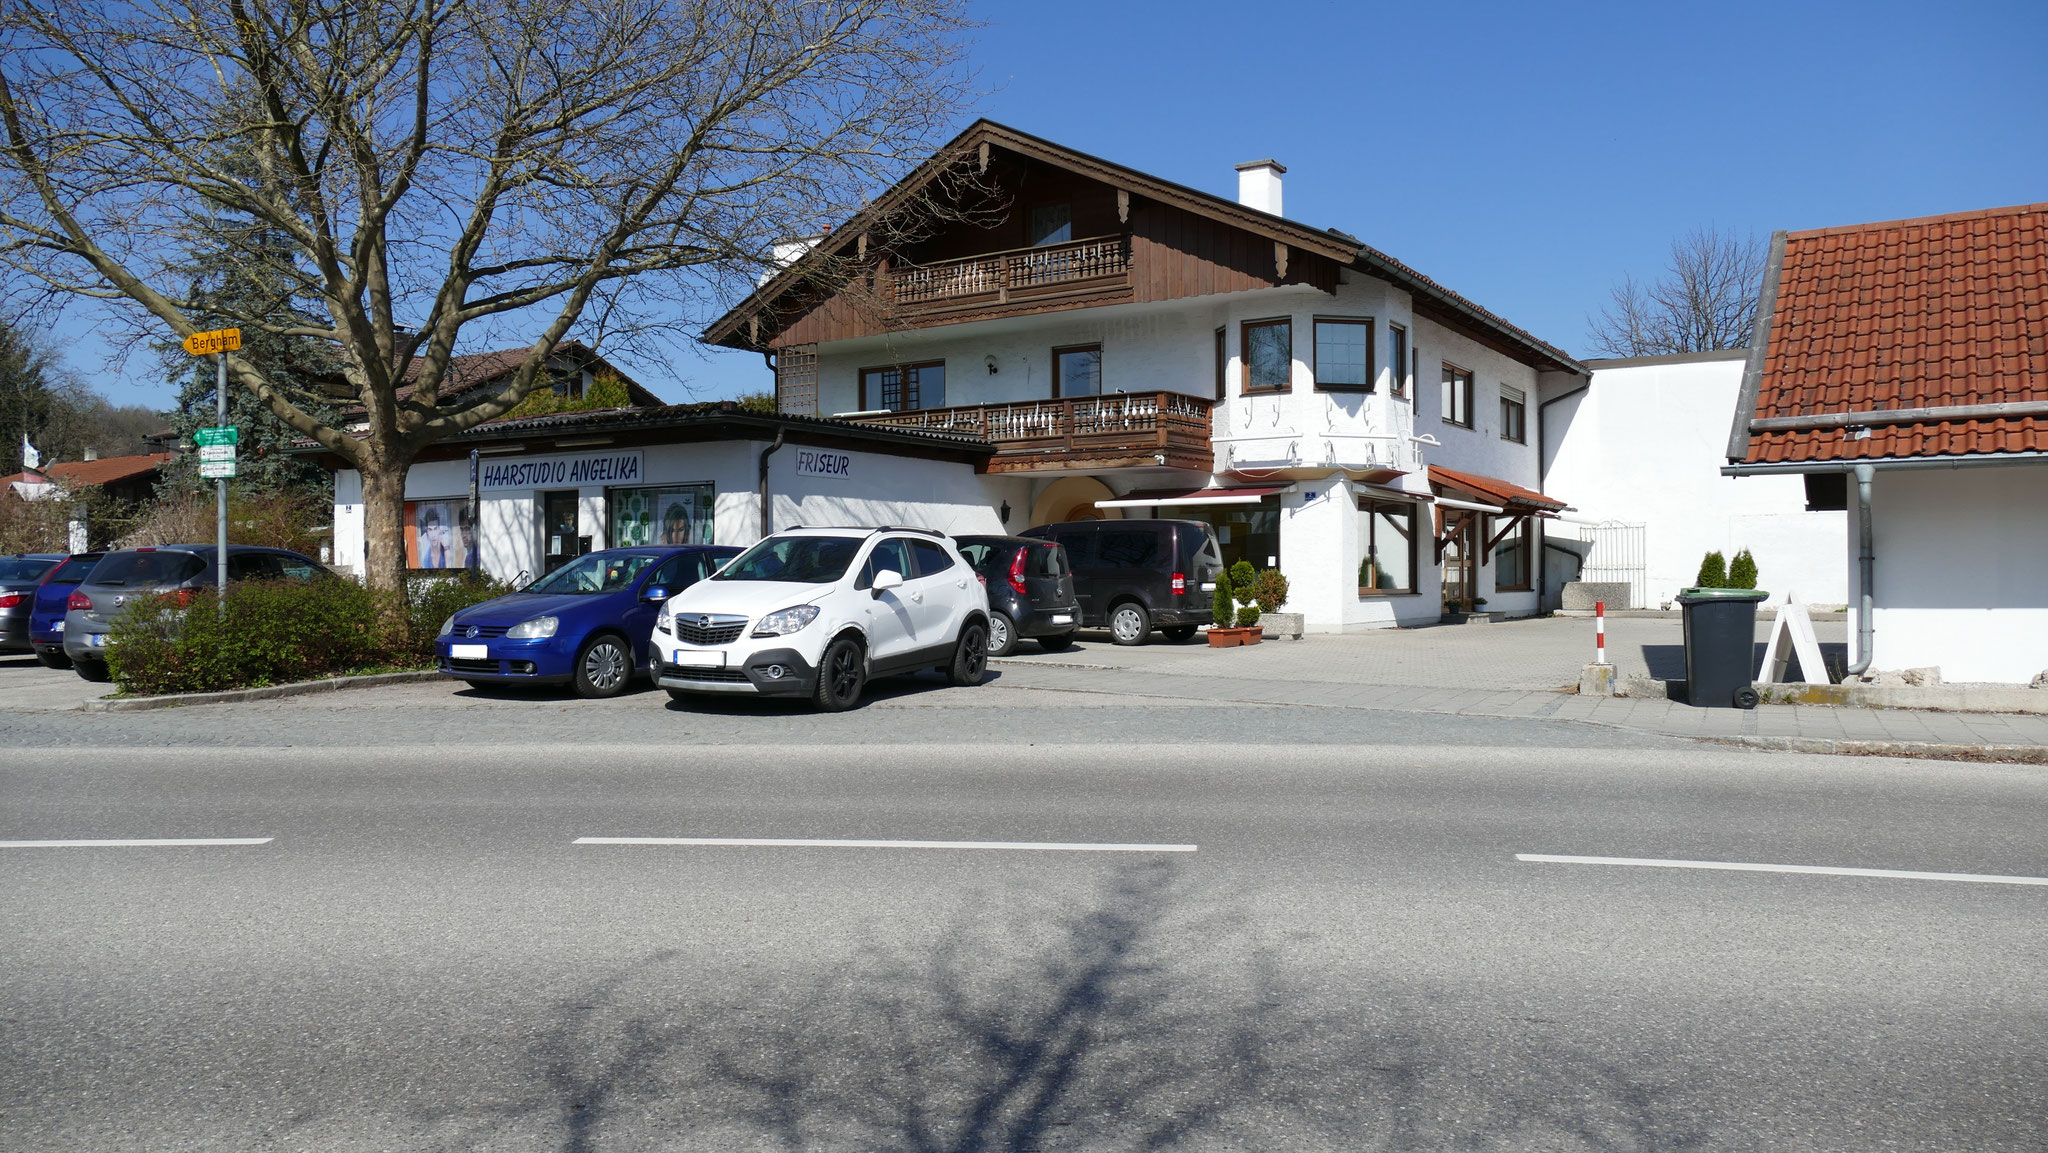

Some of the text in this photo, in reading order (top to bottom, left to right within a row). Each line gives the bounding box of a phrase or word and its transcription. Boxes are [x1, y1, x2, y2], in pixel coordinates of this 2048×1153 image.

[192, 335, 238, 350] Bergham
[484, 456, 638, 487] HAARSTUDIO ANGELIKA
[798, 451, 850, 476] FRISEUR
